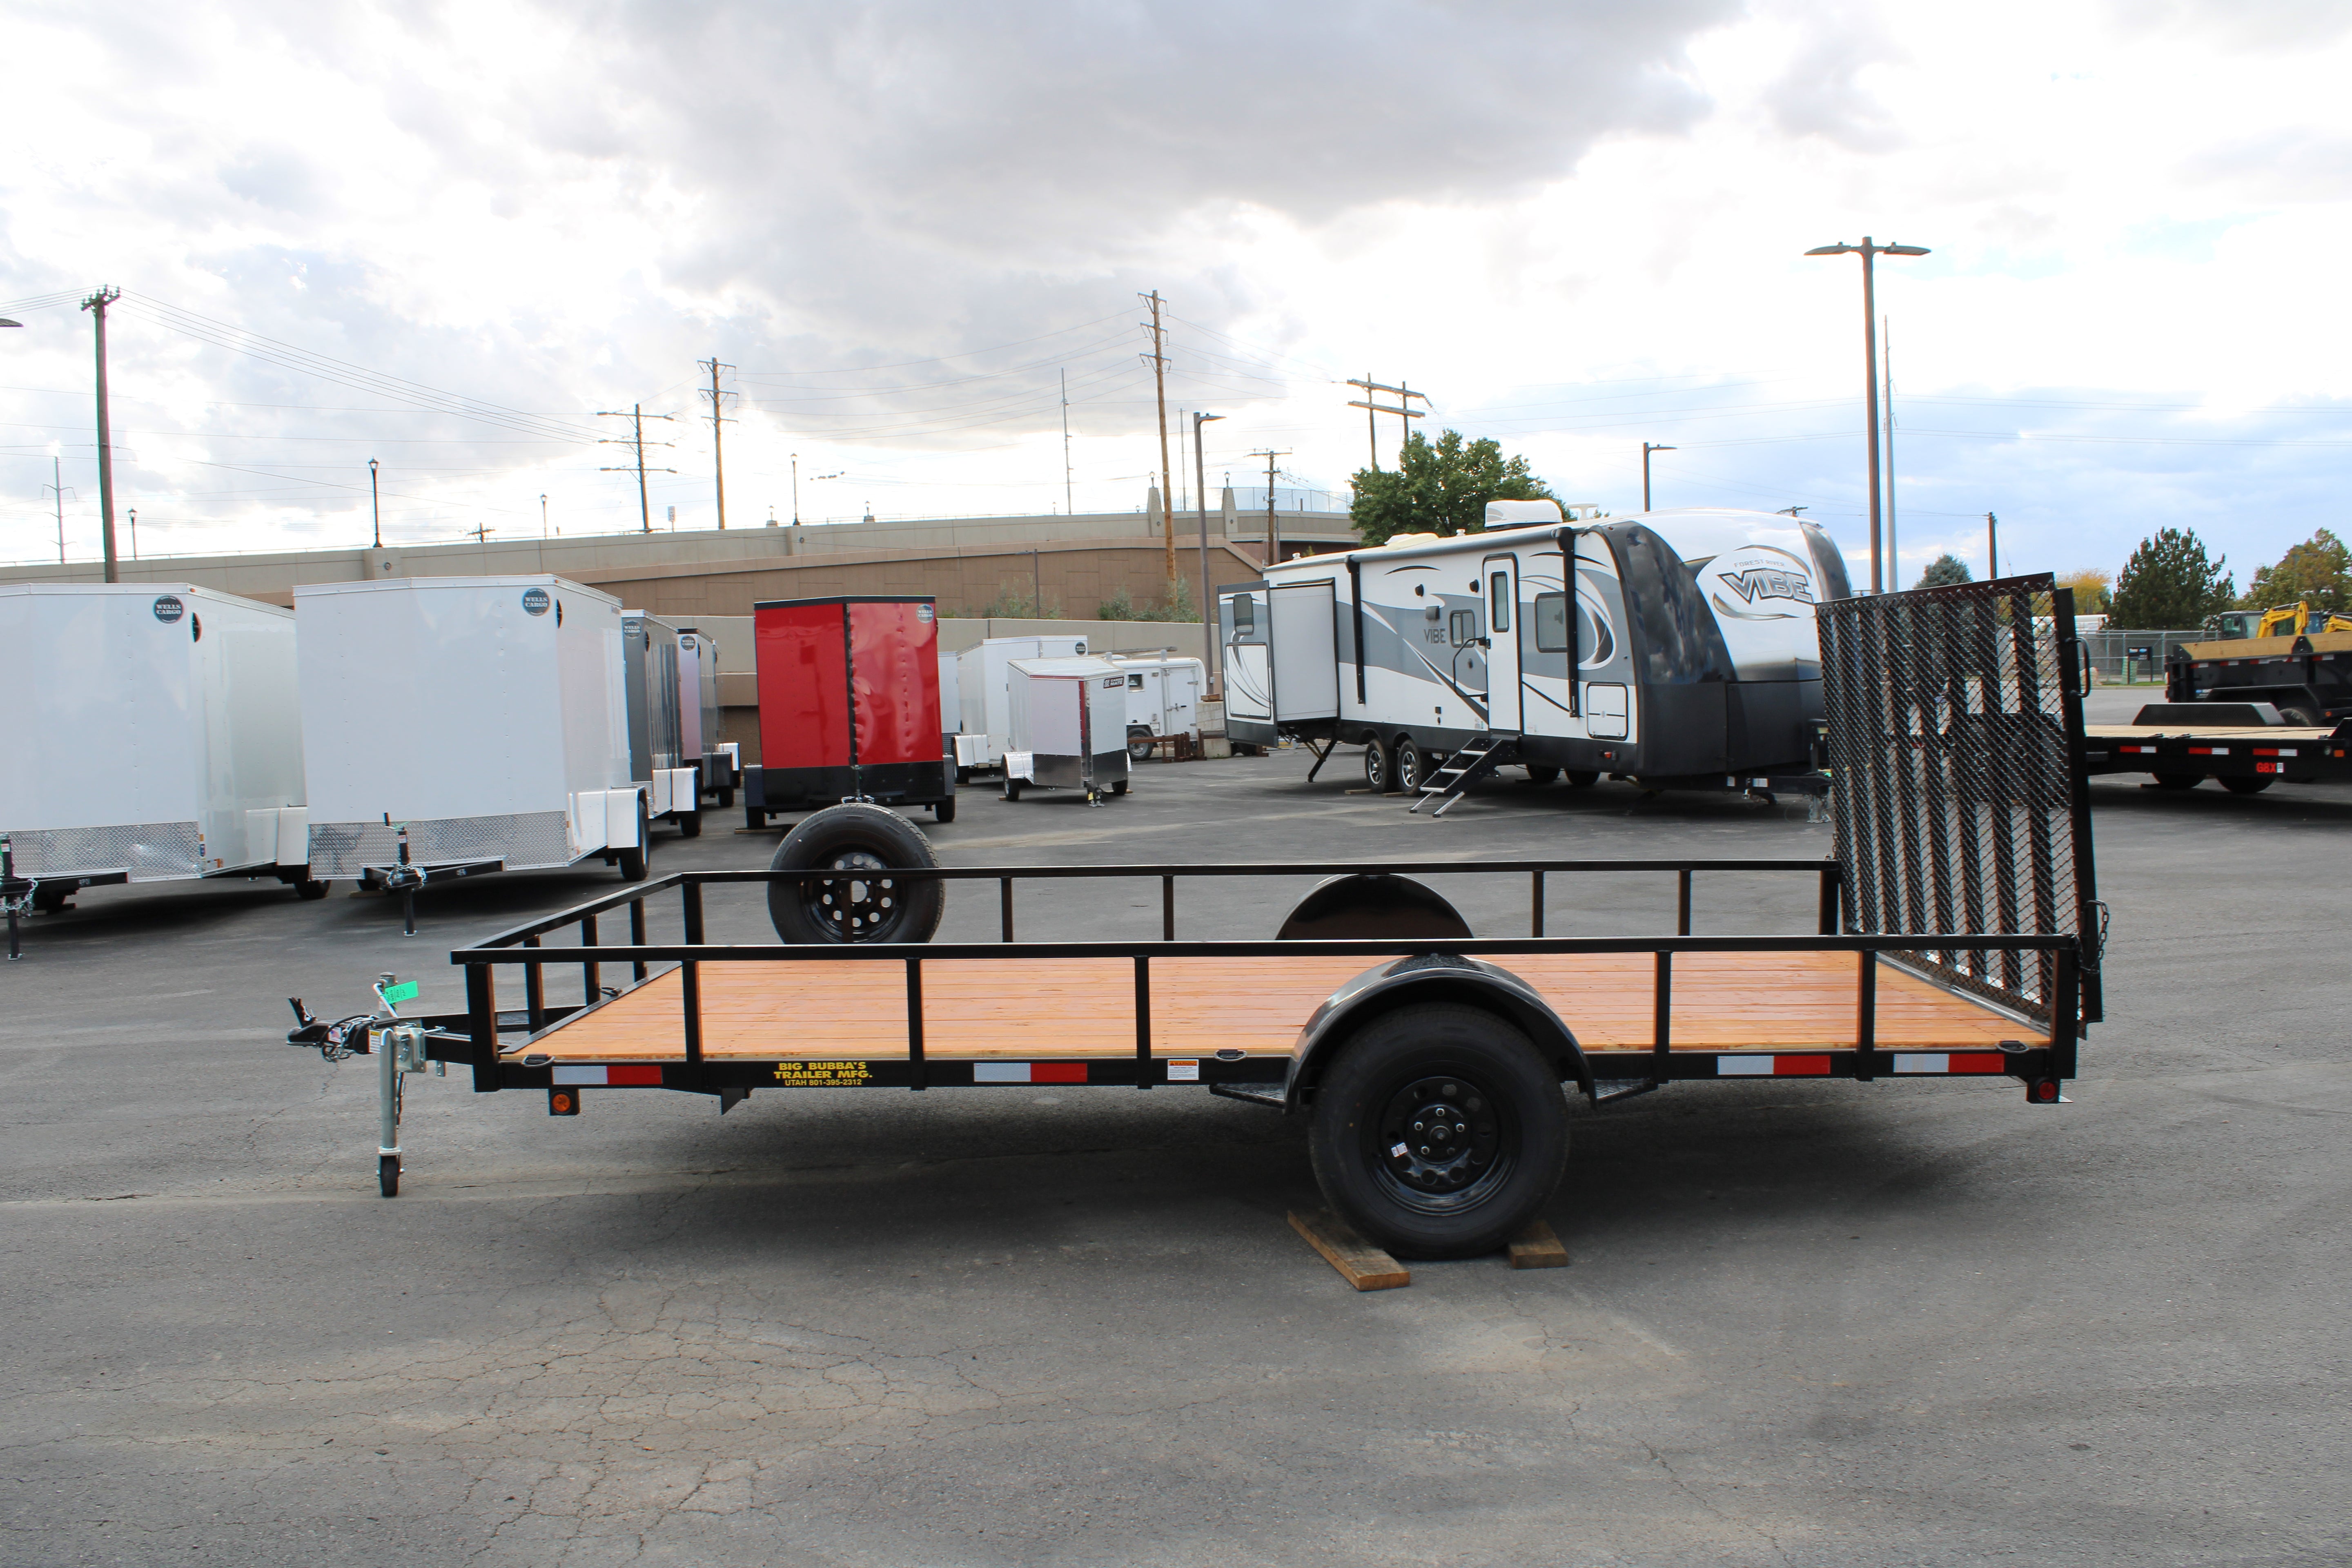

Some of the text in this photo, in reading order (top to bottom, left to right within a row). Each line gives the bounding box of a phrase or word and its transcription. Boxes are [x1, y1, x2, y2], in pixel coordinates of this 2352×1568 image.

[1734, 559, 1764, 568] FOREST
[1716, 568, 1814, 605] VIBE
[1423, 628, 1446, 644] VIBE
[808, 1062, 867, 1070] BUBBA'S
[837, 1070, 873, 1078] MFG.
